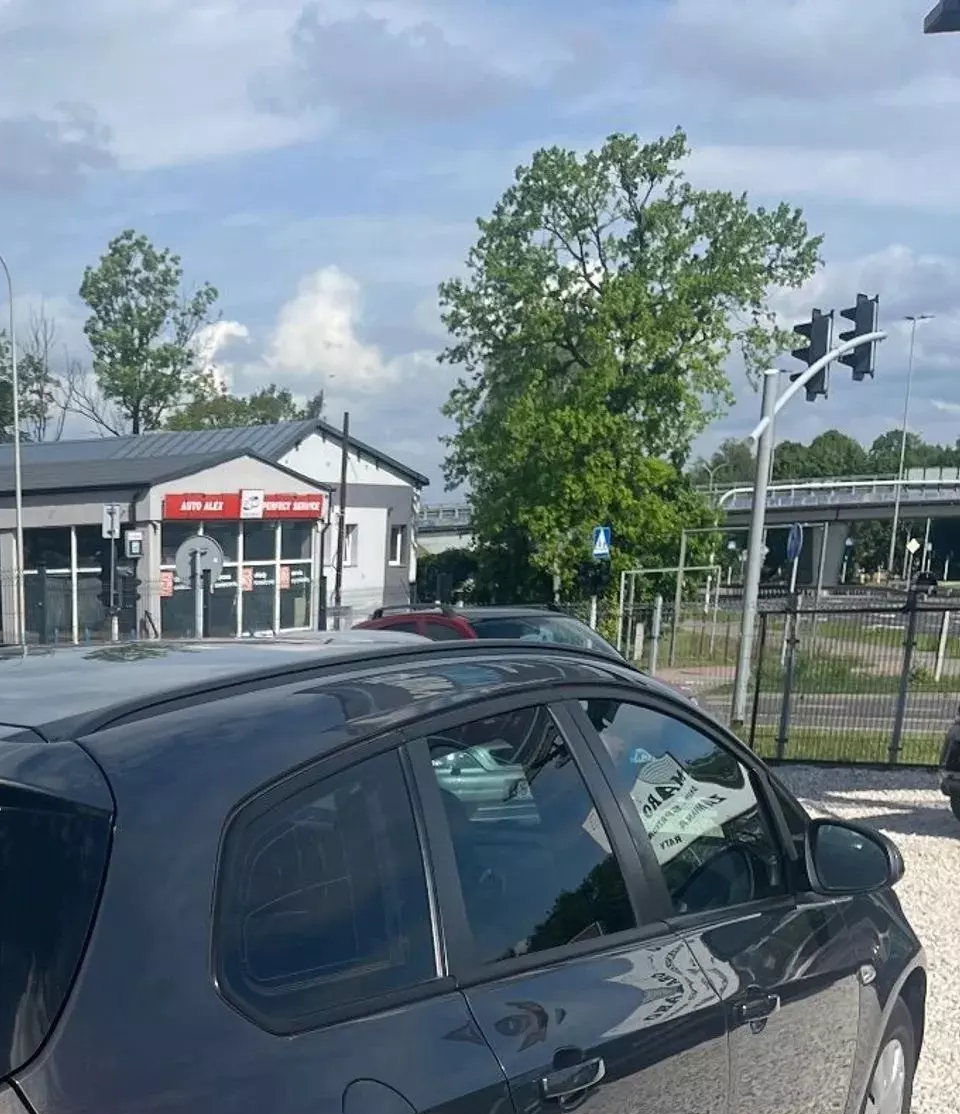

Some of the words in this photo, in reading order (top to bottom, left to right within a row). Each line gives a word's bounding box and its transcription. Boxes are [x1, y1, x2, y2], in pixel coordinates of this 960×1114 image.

[180, 501, 201, 511] AUTO
[203, 501, 224, 511] ALEX
[292, 501, 321, 511] SERVICE
